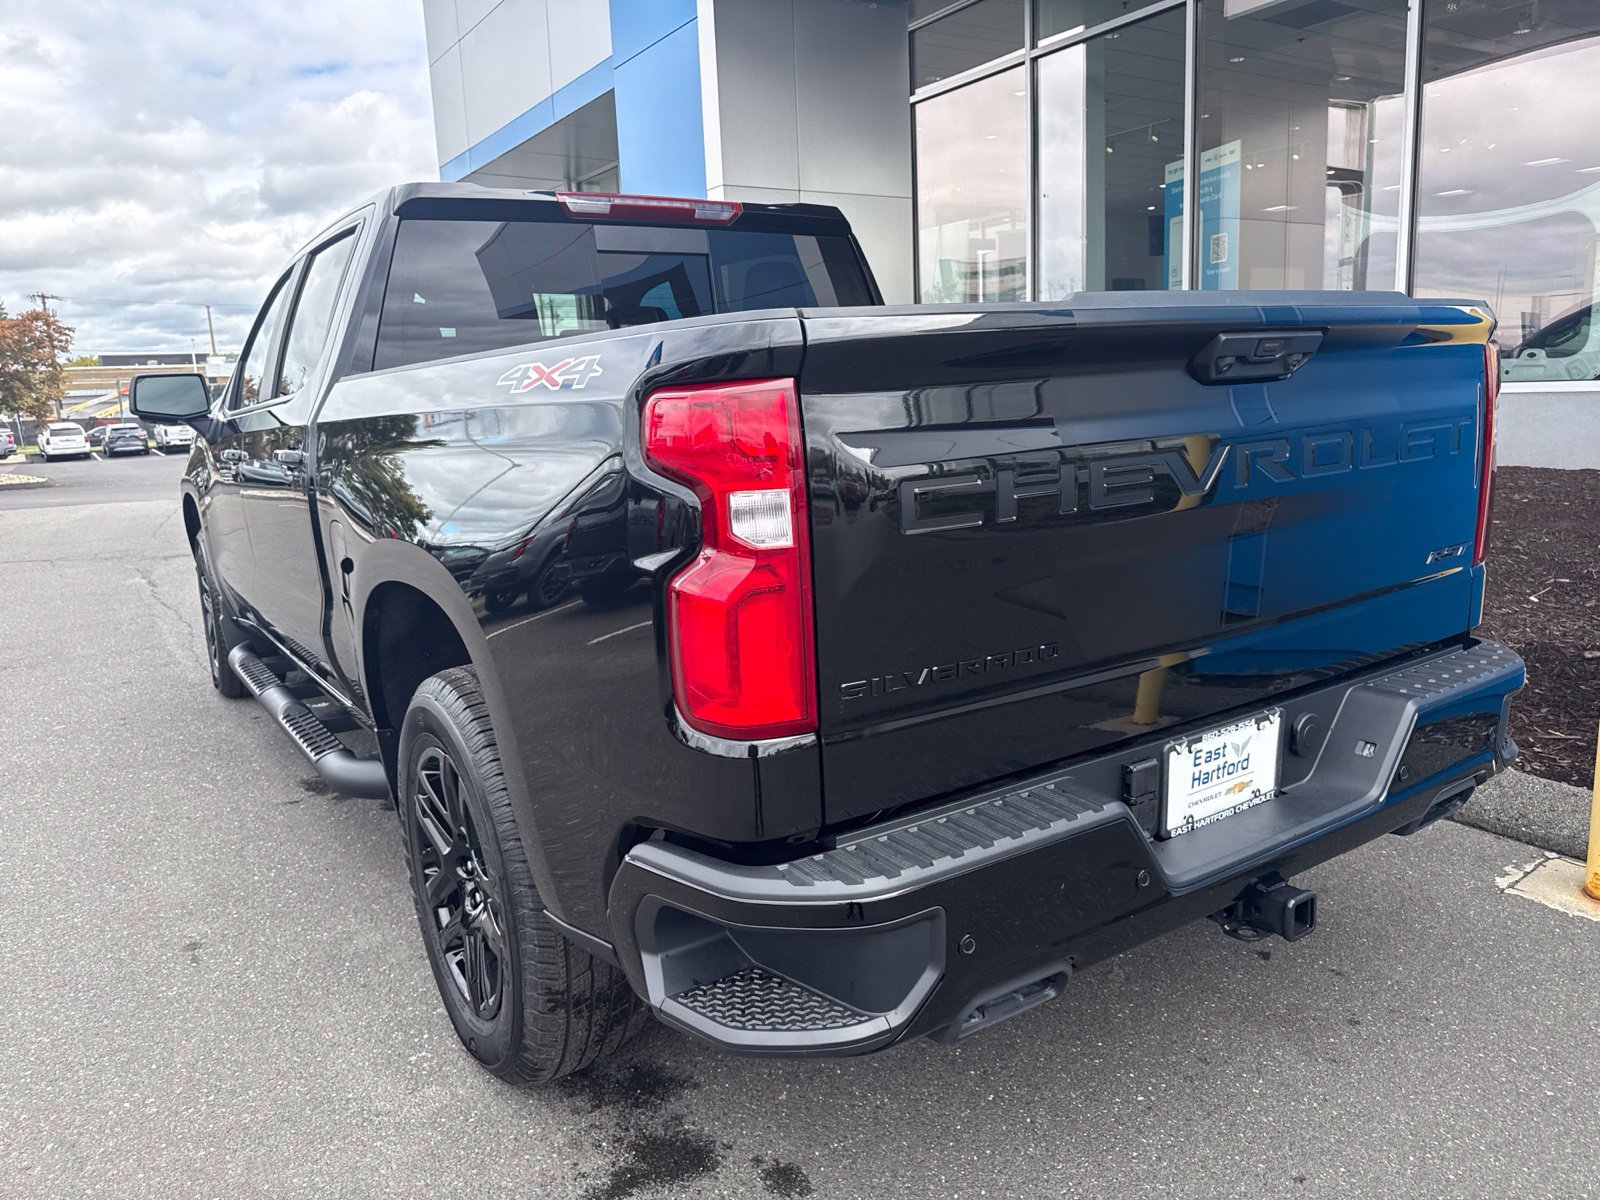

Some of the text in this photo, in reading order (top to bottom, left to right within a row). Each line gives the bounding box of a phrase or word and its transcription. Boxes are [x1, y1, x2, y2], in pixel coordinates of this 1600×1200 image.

[900, 417, 1473, 536] CHEVROLET
[1425, 542, 1470, 565] RST
[840, 642, 1060, 700] SILVERADO
[1191, 752, 1250, 789] Hartford
[1193, 742, 1227, 767] East
[1170, 790, 1276, 838] EAST HARTFORD CHEVROLET
[1187, 791, 1223, 809] CHEVROLET
